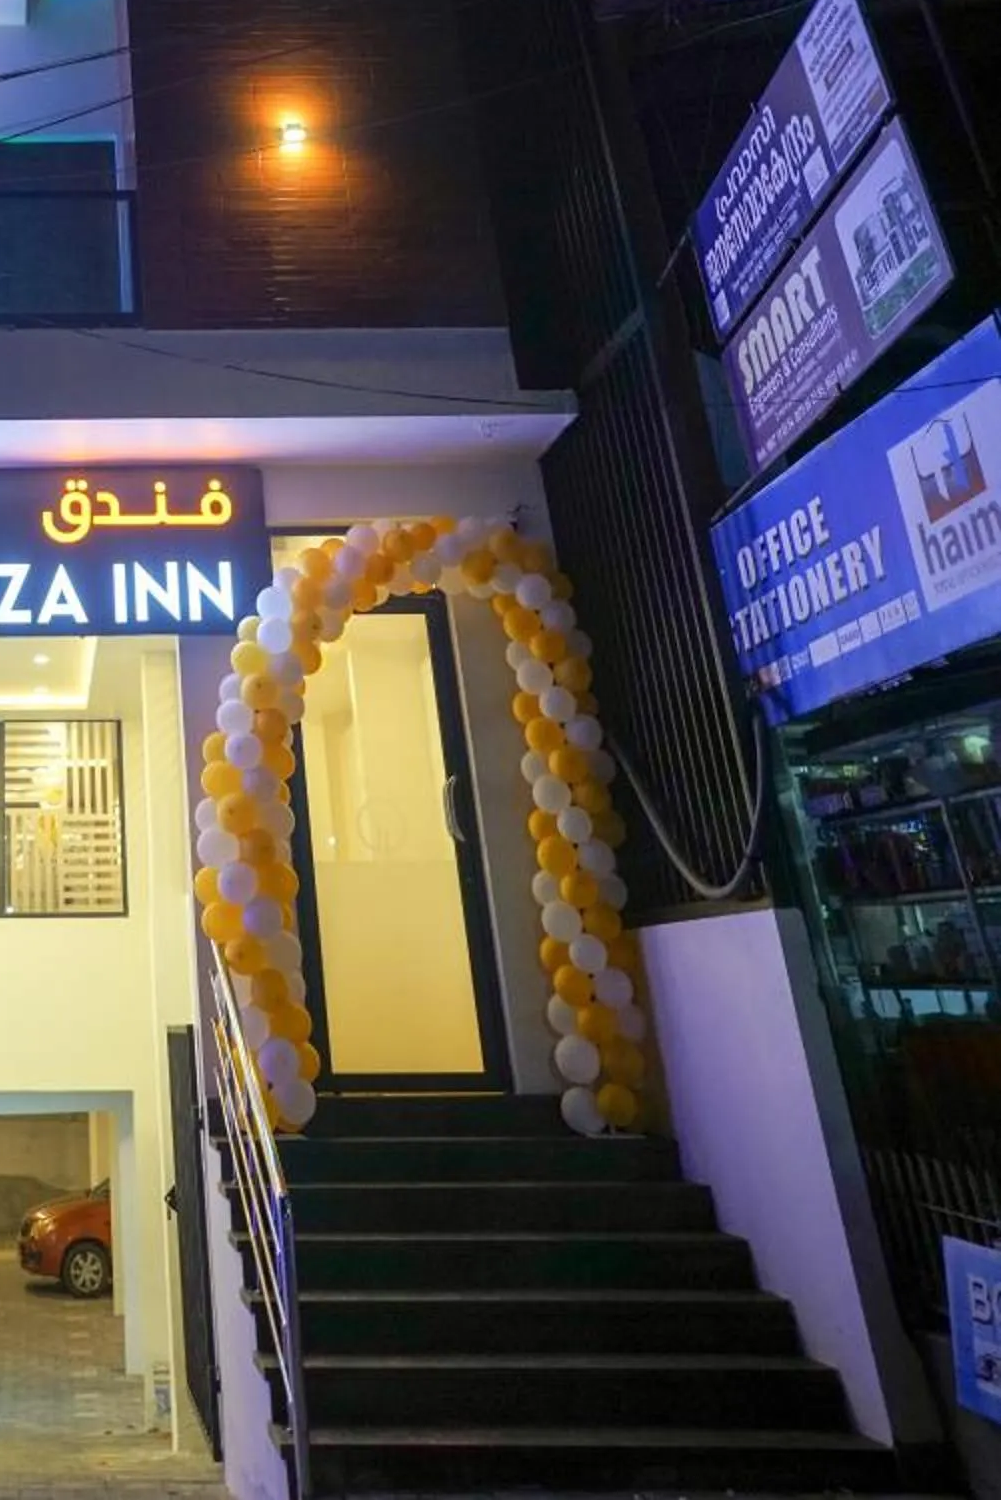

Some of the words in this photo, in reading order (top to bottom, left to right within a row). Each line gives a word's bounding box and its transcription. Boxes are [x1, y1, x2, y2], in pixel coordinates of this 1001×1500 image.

[715, 104, 777, 220] പ്രവാസി
[738, 244, 828, 394] SMART
[787, 305, 839, 370] Consultants
[42, 479, 233, 544] فندق
[737, 497, 830, 589] OFFICE
[112, 560, 235, 623] INN
[969, 1273, 1001, 1326] B
